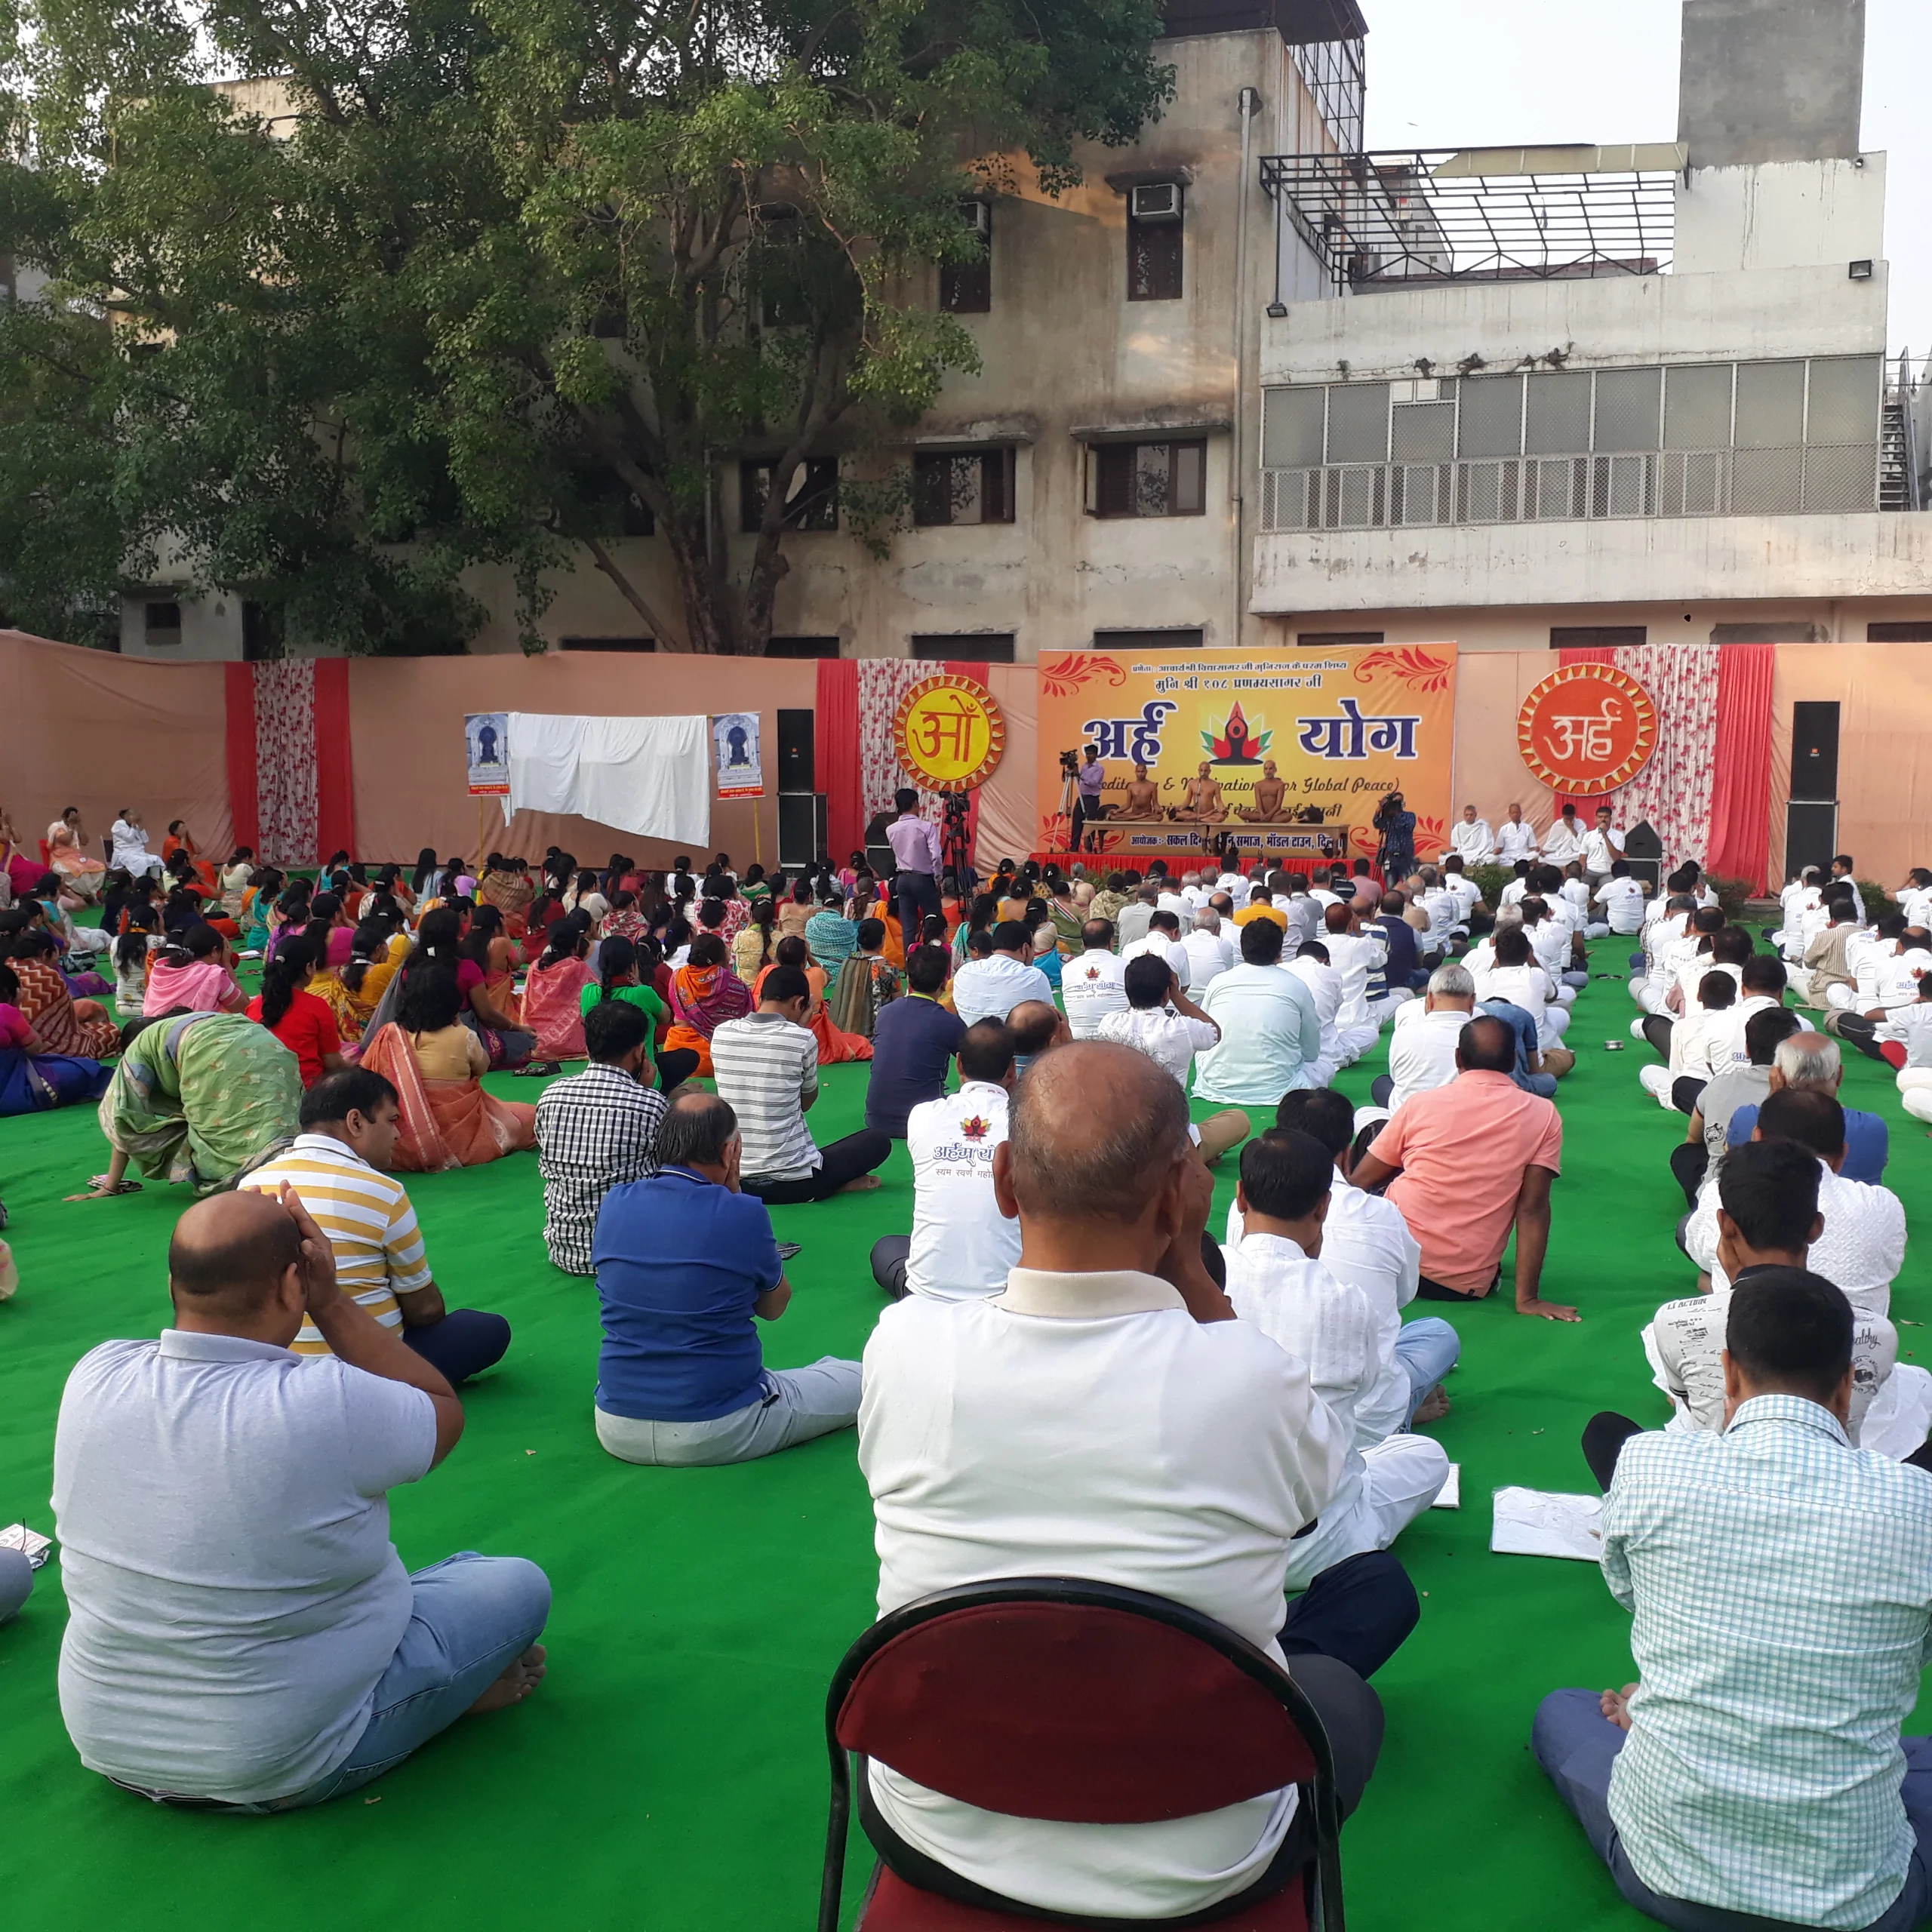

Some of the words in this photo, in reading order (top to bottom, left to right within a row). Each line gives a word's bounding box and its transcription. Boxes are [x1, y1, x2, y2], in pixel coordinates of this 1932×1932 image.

[1254, 662, 1290, 672] मुनिराज
[1292, 662, 1300, 670] के
[1324, 660, 1347, 669] शिष्य
[1155, 676, 1179, 693] मुनि
[1183, 676, 1198, 689] श्री
[1204, 679, 1228, 689] १०८
[1234, 678, 1301, 688] प्रणम्यसागर
[1306, 674, 1321, 687] जी
[1297, 699, 1420, 758] योग
[1163, 777, 1175, 791] &
[1302, 777, 1349, 793] Global
[1352, 777, 1400, 793] Peace)
[1166, 835, 1188, 845] सकल
[1266, 832, 1290, 847] मॉडल
[933, 1143, 977, 1167] अर्हम्
